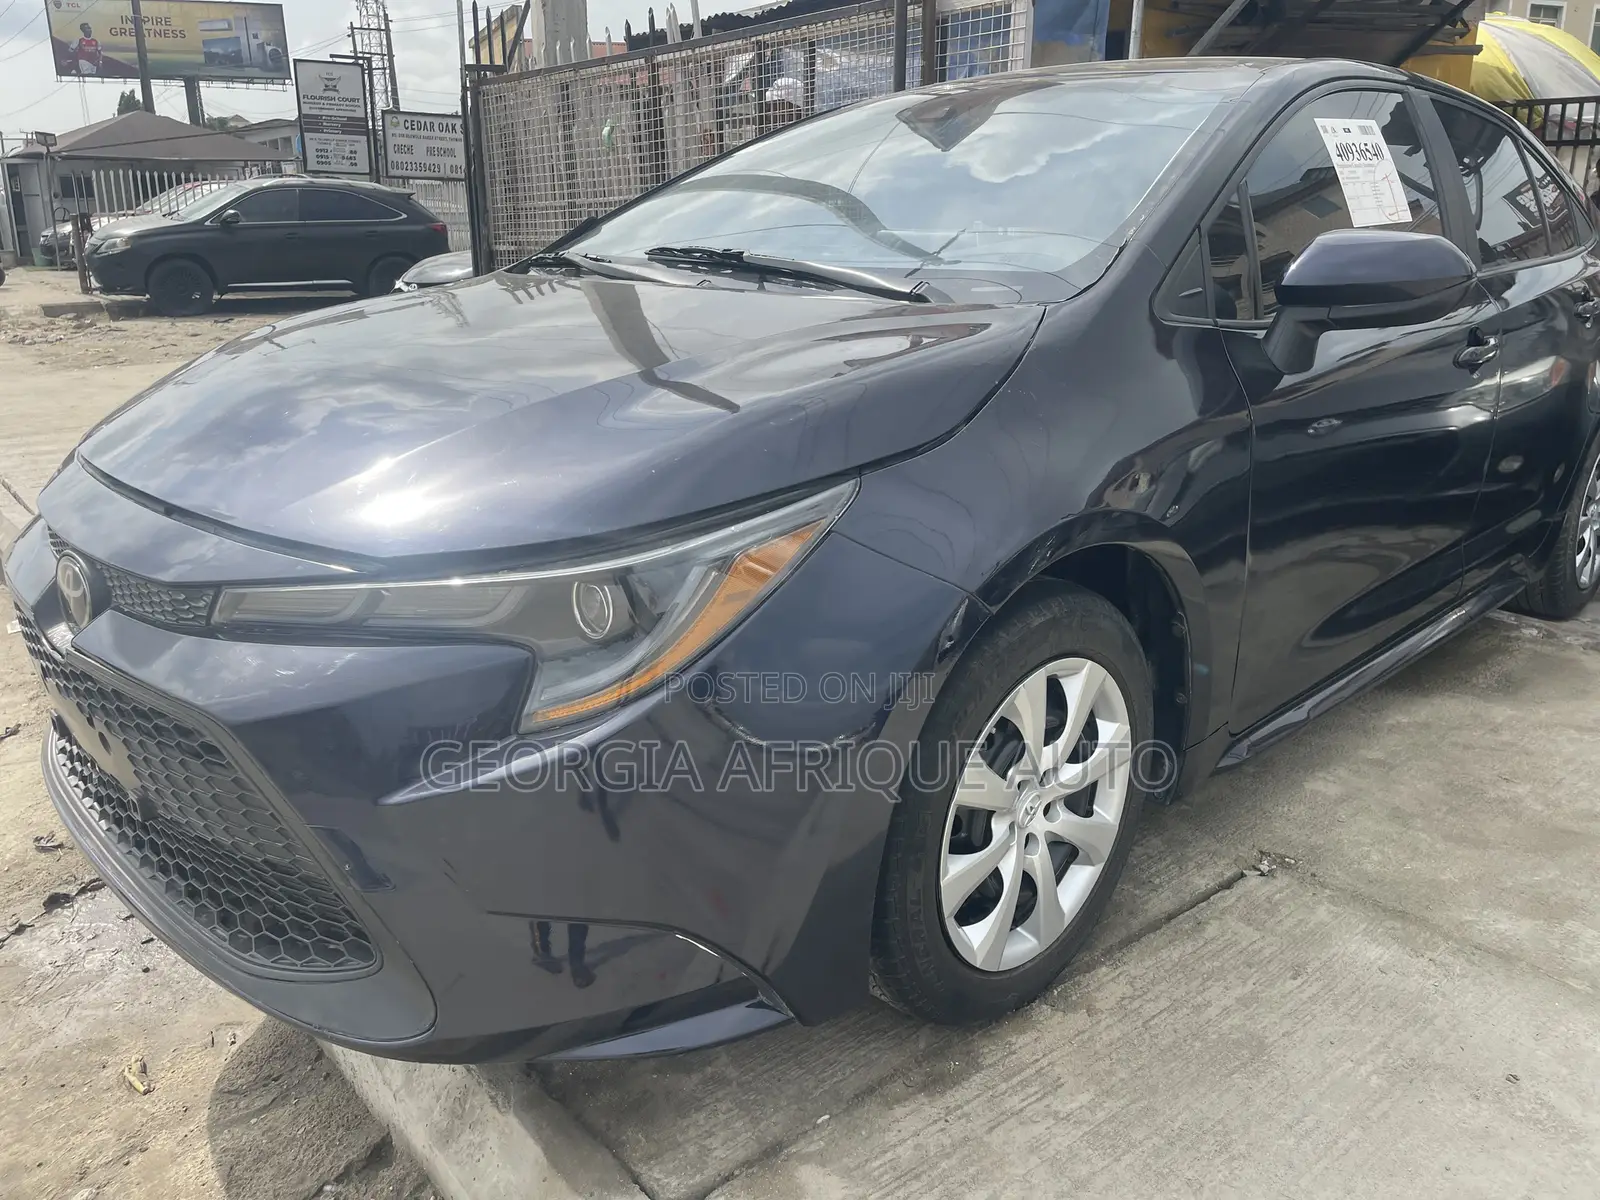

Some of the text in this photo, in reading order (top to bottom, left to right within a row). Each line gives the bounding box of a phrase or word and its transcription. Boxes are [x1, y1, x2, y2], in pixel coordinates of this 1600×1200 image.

[120, 15, 172, 26] INPIRE
[110, 27, 186, 39] GRETNESS
[302, 94, 336, 102] FLOURISH
[403, 119, 435, 132] CEDAR
[438, 122, 457, 134] OAK
[393, 144, 414, 155] CRECHE
[1335, 142, 1385, 161] 40936540
[390, 160, 441, 173] 08023359429
